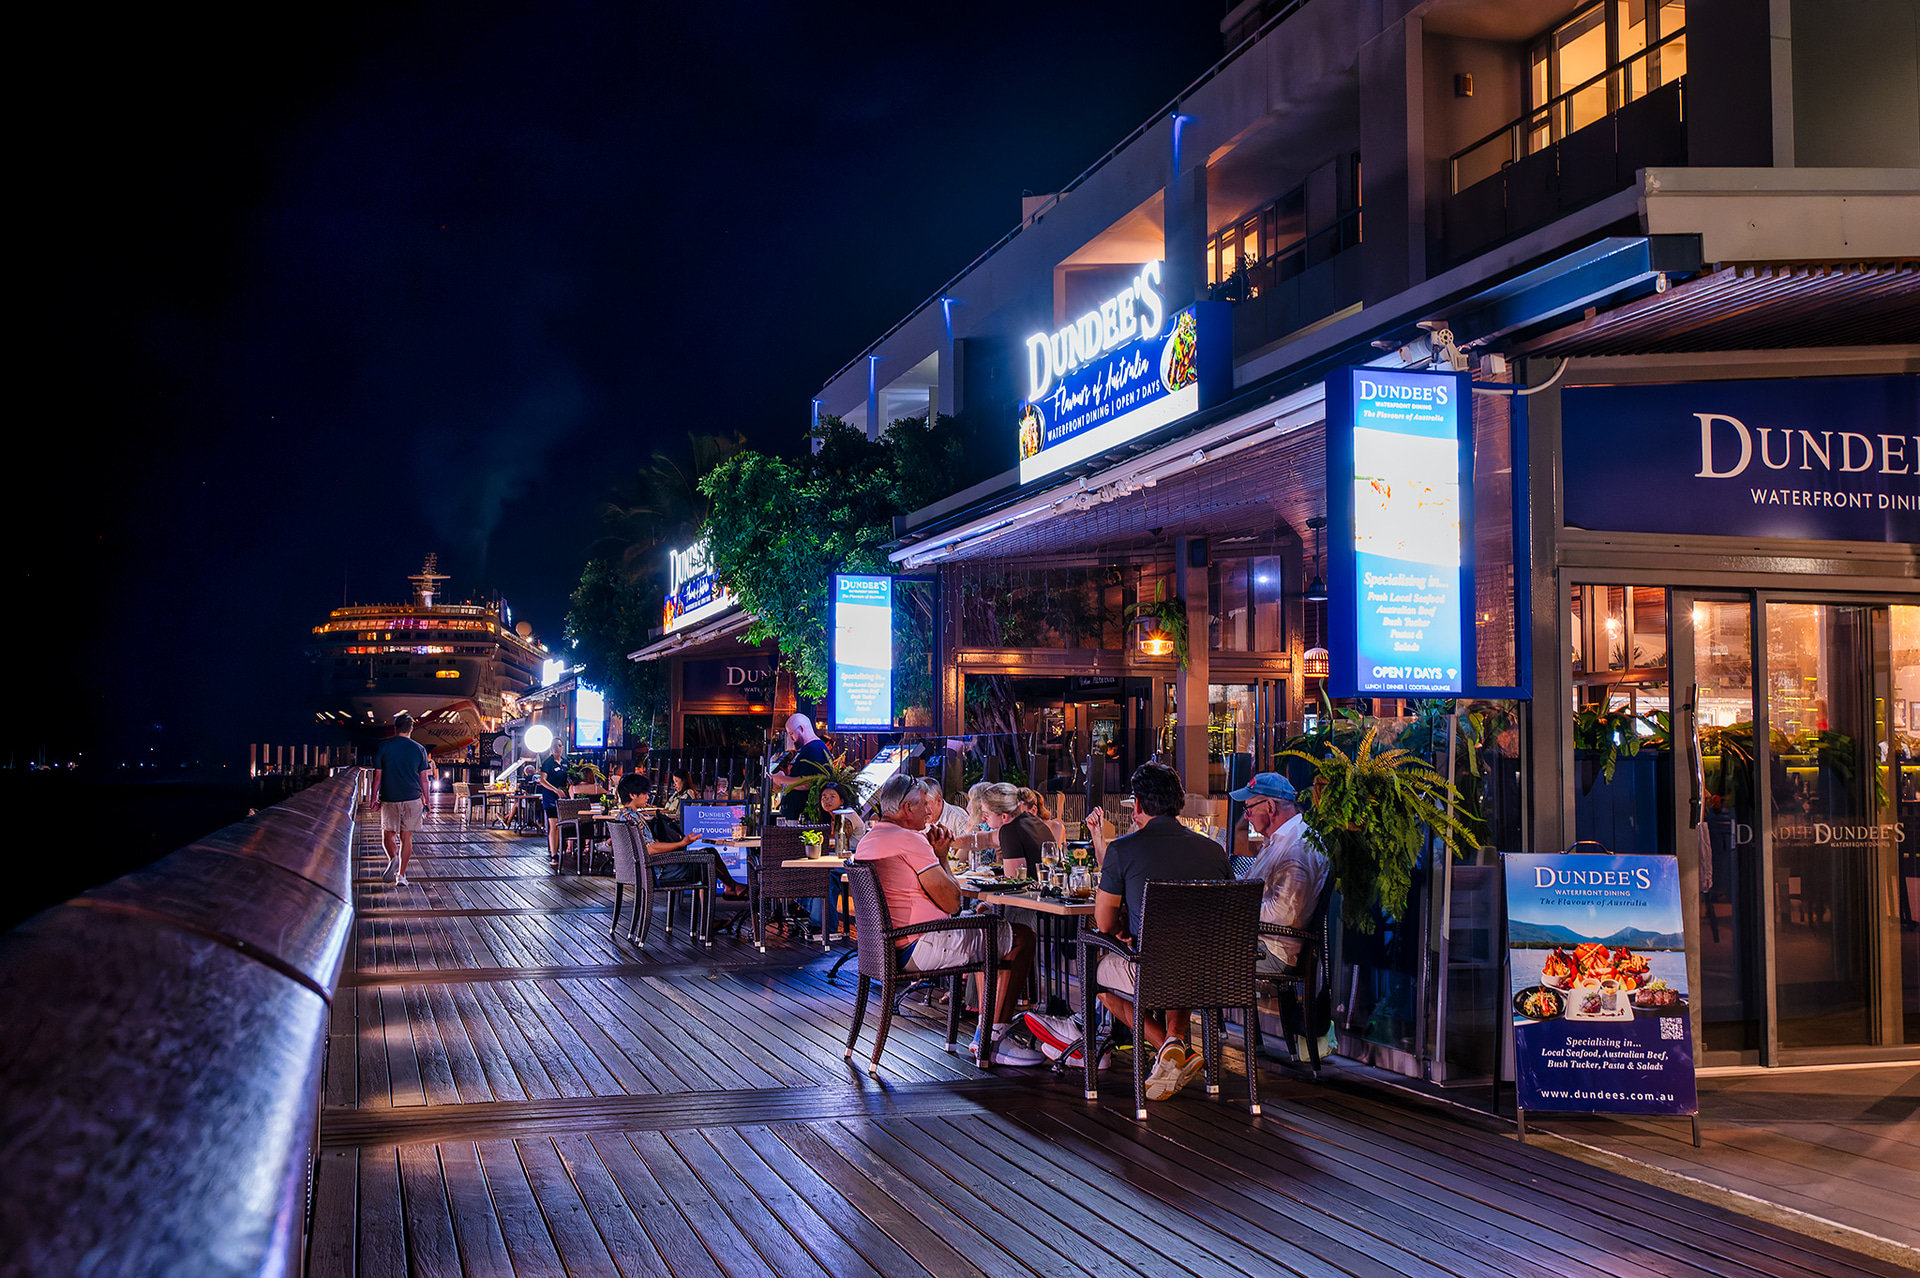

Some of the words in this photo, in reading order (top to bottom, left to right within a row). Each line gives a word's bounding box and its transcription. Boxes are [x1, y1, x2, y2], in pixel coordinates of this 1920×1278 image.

[1026, 259, 1163, 403] DUNDEE'S
[1093, 371, 1103, 406] of
[1104, 350, 1150, 400] Australia
[1360, 380, 1448, 405] DUNDEE'S
[1047, 414, 1086, 442] WATERFRONT
[1086, 403, 1110, 425] DINING
[1116, 390, 1135, 411] OPEN
[1136, 388, 1141, 401] 7
[1142, 379, 1160, 399] DAYS
[1363, 410, 1376, 418] The
[1405, 413, 1414, 422] of
[1413, 413, 1444, 422] Australia
[1751, 488, 1874, 512] WATERFRONT
[1879, 493, 1920, 512] DINI
[840, 579, 888, 592] DUNDEE'S
[1372, 665, 1403, 678] OPEN
[1404, 667, 1412, 679] 7
[1413, 667, 1443, 680] DAYS
[1812, 822, 1906, 844] DUNDEE'S
[1534, 866, 1651, 889] DUNDEE'S
[1555, 889, 1603, 897] WATERFRONT
[1603, 889, 1631, 897] DINING
[1540, 898, 1555, 906] The
[1557, 898, 1595, 906] Flavours
[1596, 899, 1605, 907] of
[1566, 1037, 1621, 1049] Specialising
[1623, 1038, 1642, 1048] in...
[1541, 1048, 1565, 1057] Local
[1566, 1048, 1601, 1059] Seafood,
[1602, 1050, 1645, 1059] Australian
[1647, 1051, 1669, 1061] Beef,
[1547, 1060, 1569, 1068] Bush
[1570, 1060, 1601, 1070] Tucker,
[1602, 1061, 1625, 1070] Pasta
[1626, 1061, 1634, 1070] &
[1636, 1062, 1664, 1070] Salads
[1541, 1089, 1674, 1101] www.dundees.com.au
